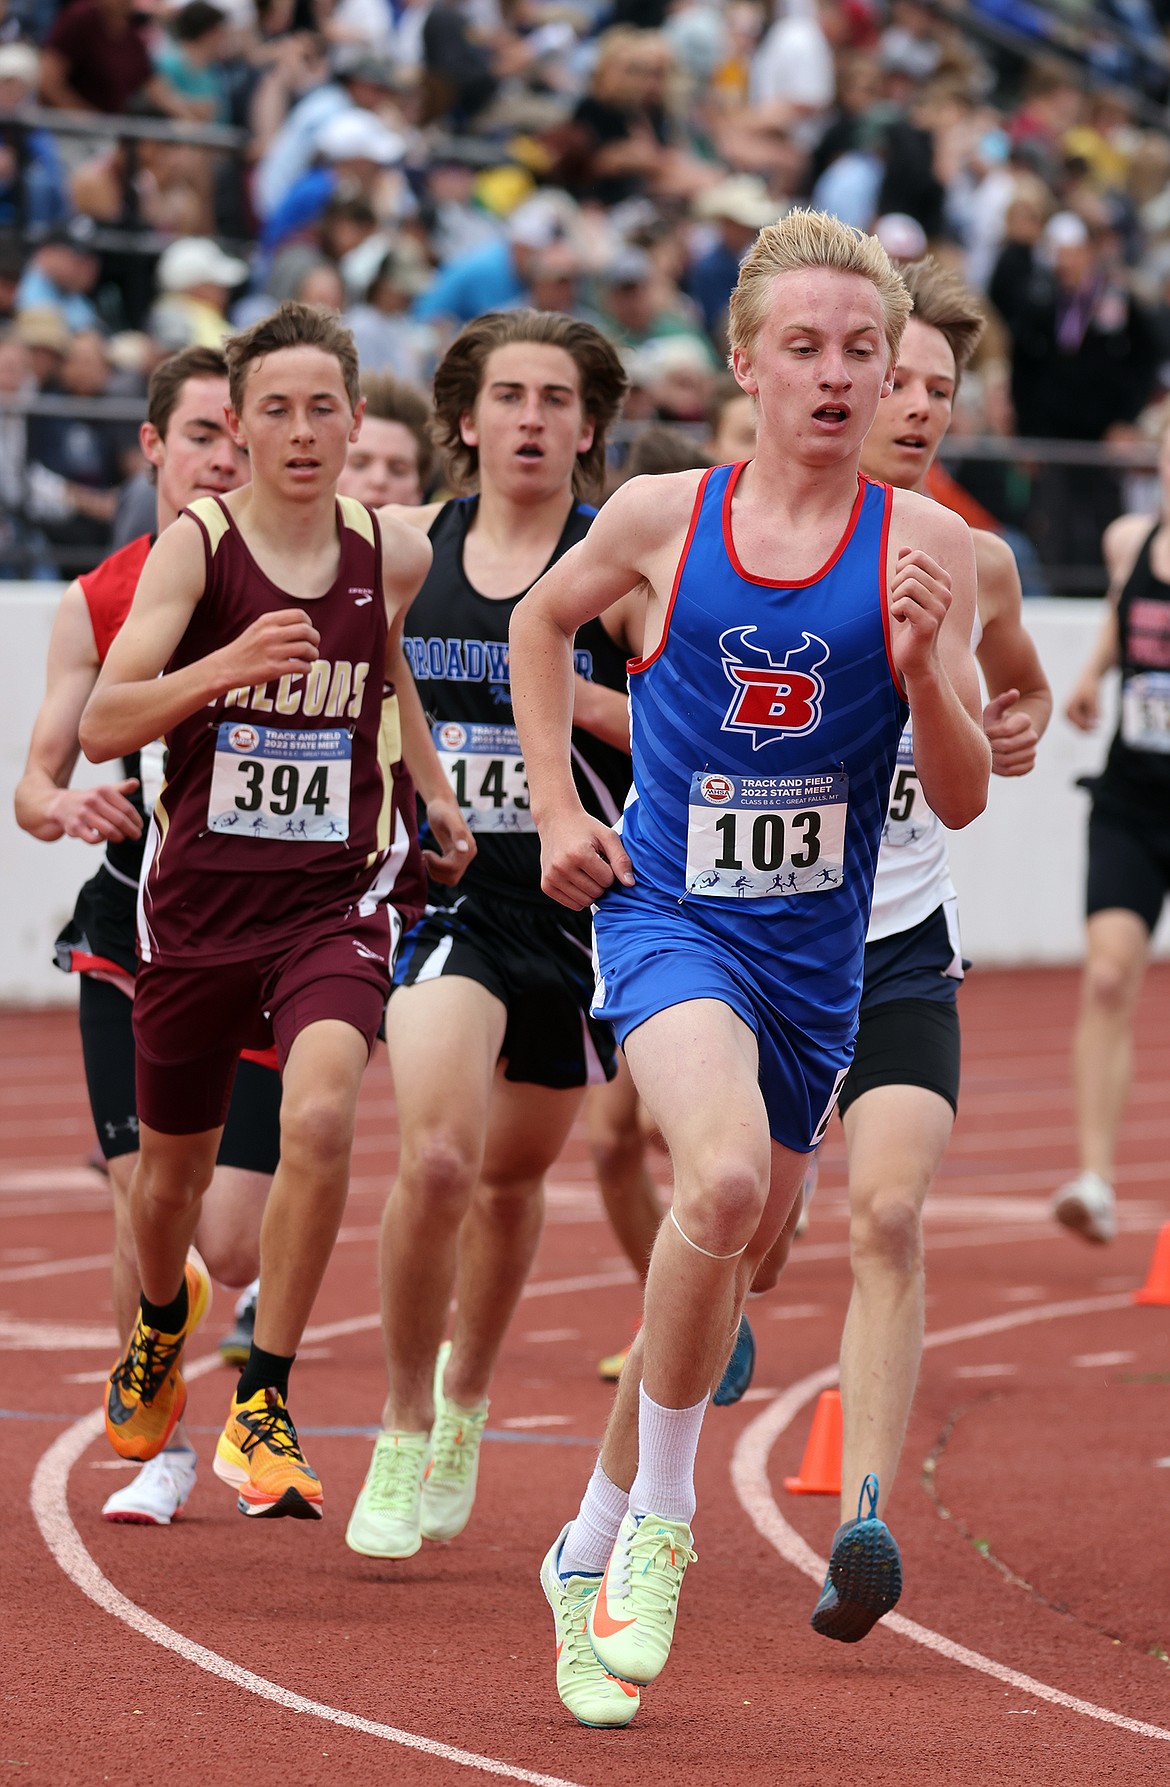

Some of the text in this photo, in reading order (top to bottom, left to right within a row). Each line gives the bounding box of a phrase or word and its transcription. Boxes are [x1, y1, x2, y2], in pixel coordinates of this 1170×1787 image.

[729, 665, 819, 732] B
[265, 730, 341, 741] TRACK AND FIELD
[264, 740, 288, 748] 2022
[290, 741, 316, 750] STATE
[318, 741, 340, 749] MEET
[234, 760, 330, 816] 394
[741, 779, 777, 788] TRACK
[779, 778, 804, 788] AND
[805, 776, 833, 787] FIELD
[741, 785, 832, 797] 2022 STATE MEET
[741, 798, 762, 806] CLASS
[786, 797, 807, 805] GREAT
[714, 811, 821, 872] 103
